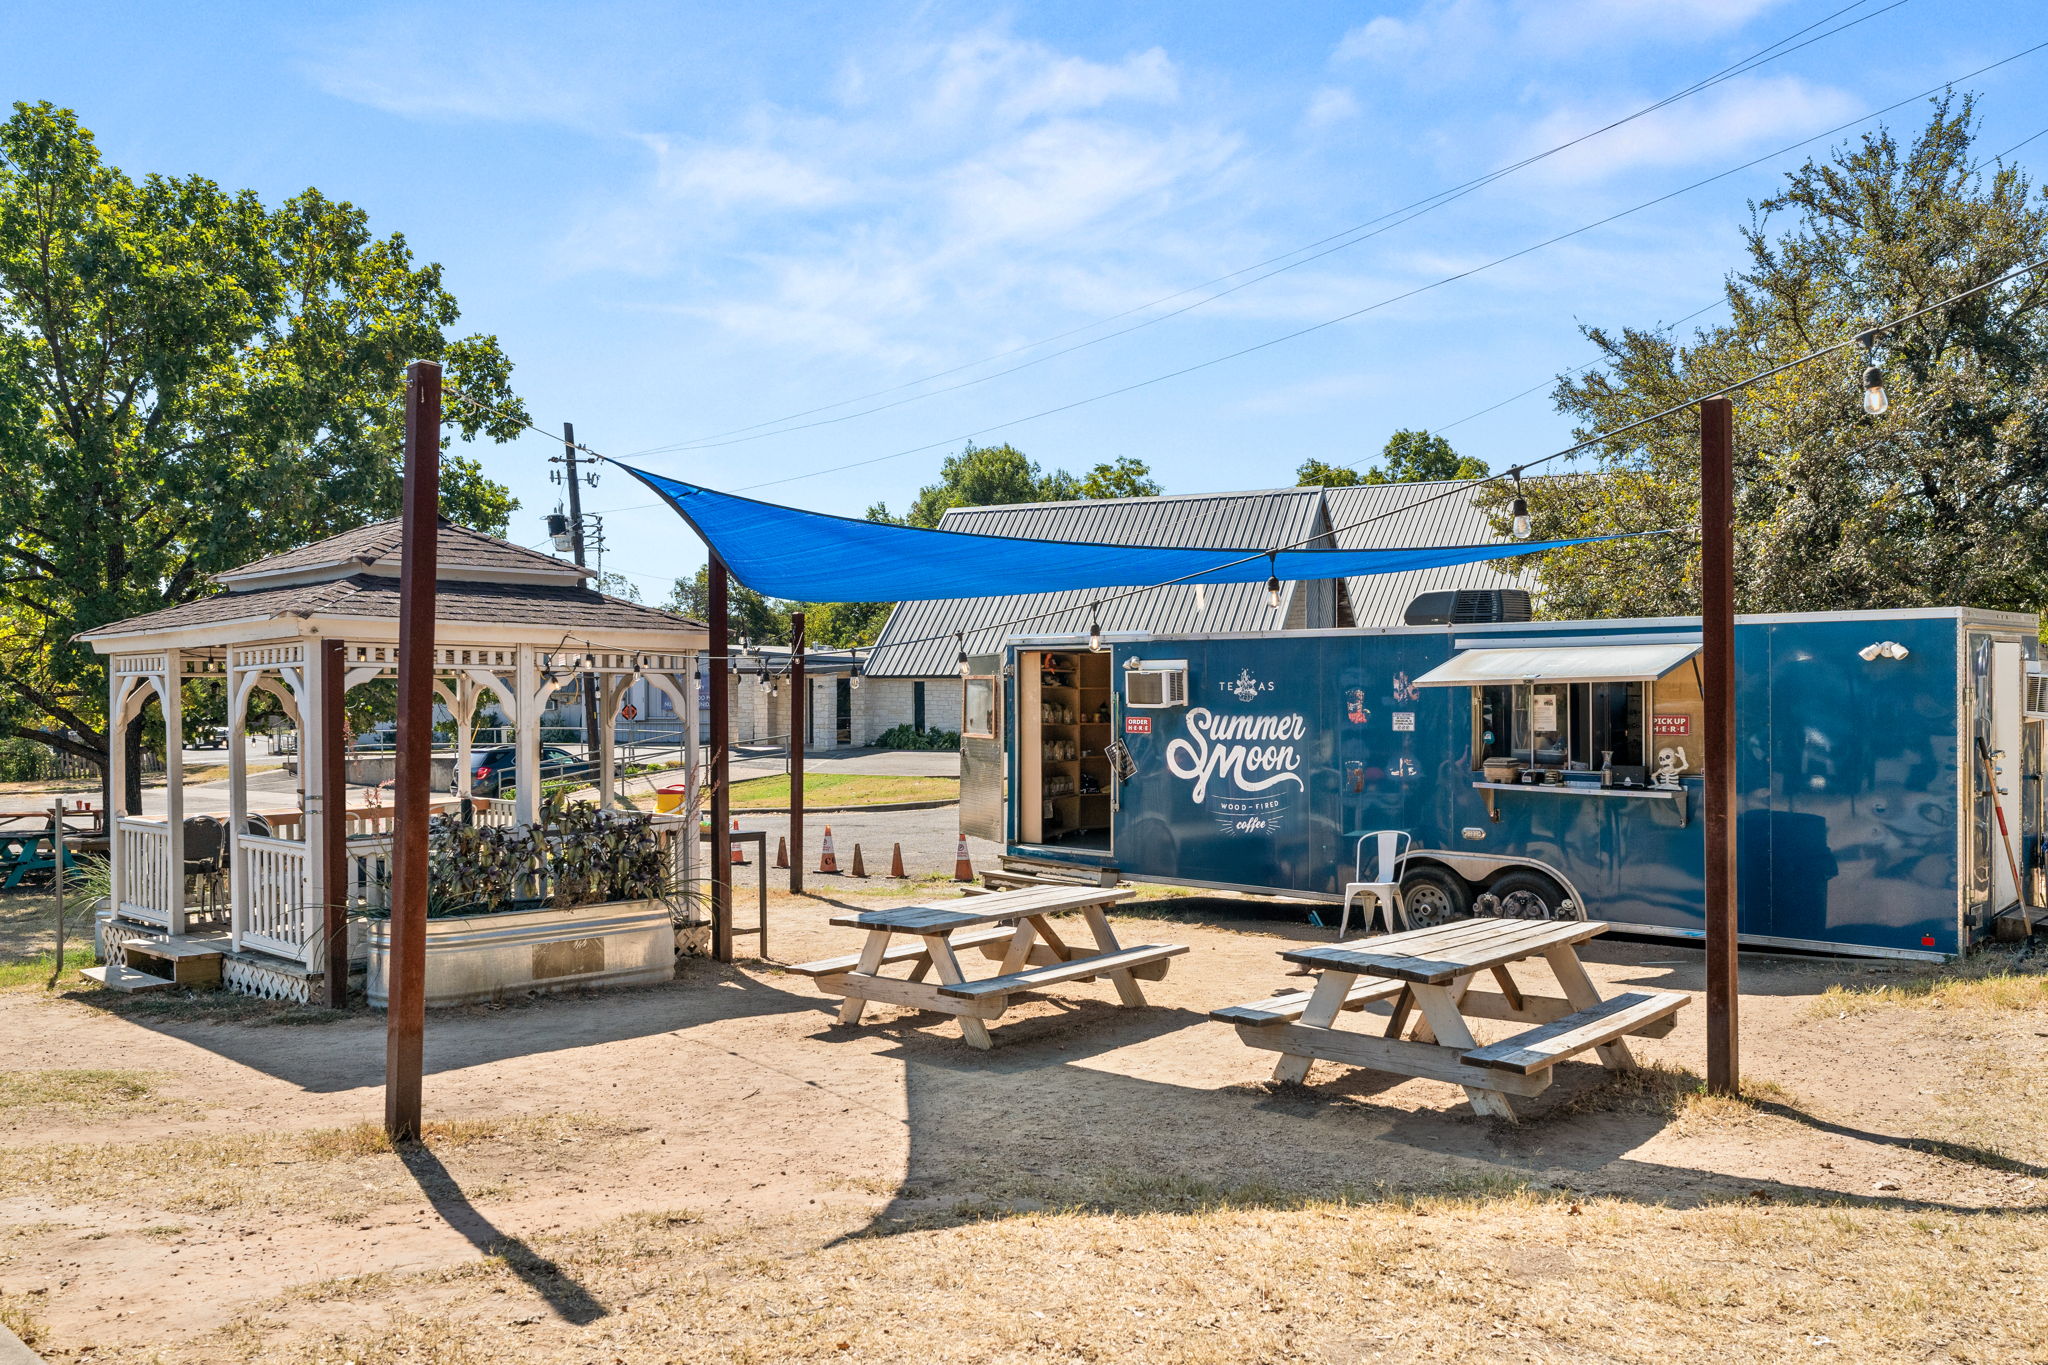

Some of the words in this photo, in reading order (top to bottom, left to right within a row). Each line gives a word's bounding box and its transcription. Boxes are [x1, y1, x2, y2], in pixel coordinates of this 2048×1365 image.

[1219, 680, 1275, 695] TEXAS
[1192, 743, 1304, 804] Moon
[1236, 816, 1266, 833] coffee
